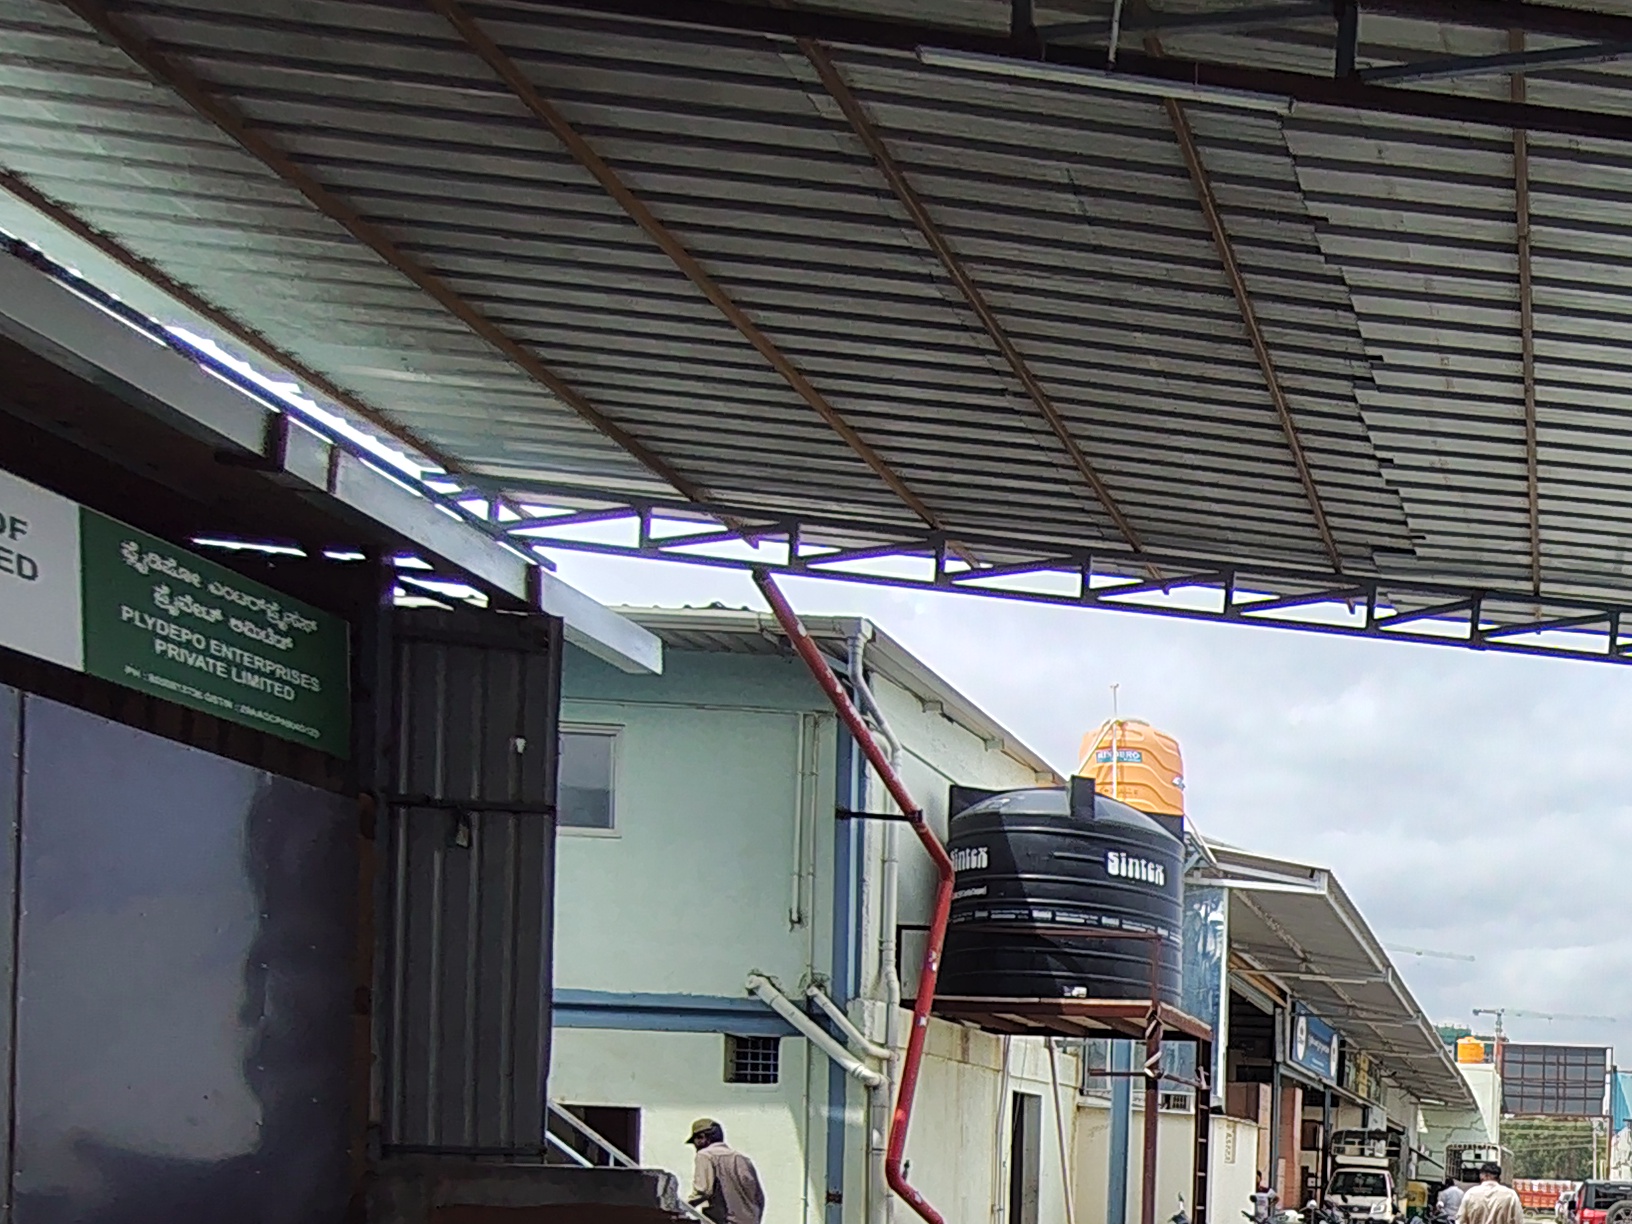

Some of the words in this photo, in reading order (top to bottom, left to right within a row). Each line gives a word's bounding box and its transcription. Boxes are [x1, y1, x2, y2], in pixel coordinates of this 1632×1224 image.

[120, 605, 206, 650] PLYDEPO
[209, 639, 321, 692] ENTERPRISES
[153, 638, 229, 679] PRIVATE
[231, 667, 296, 701] LIMITED
[1107, 851, 1165, 887] Sintex
